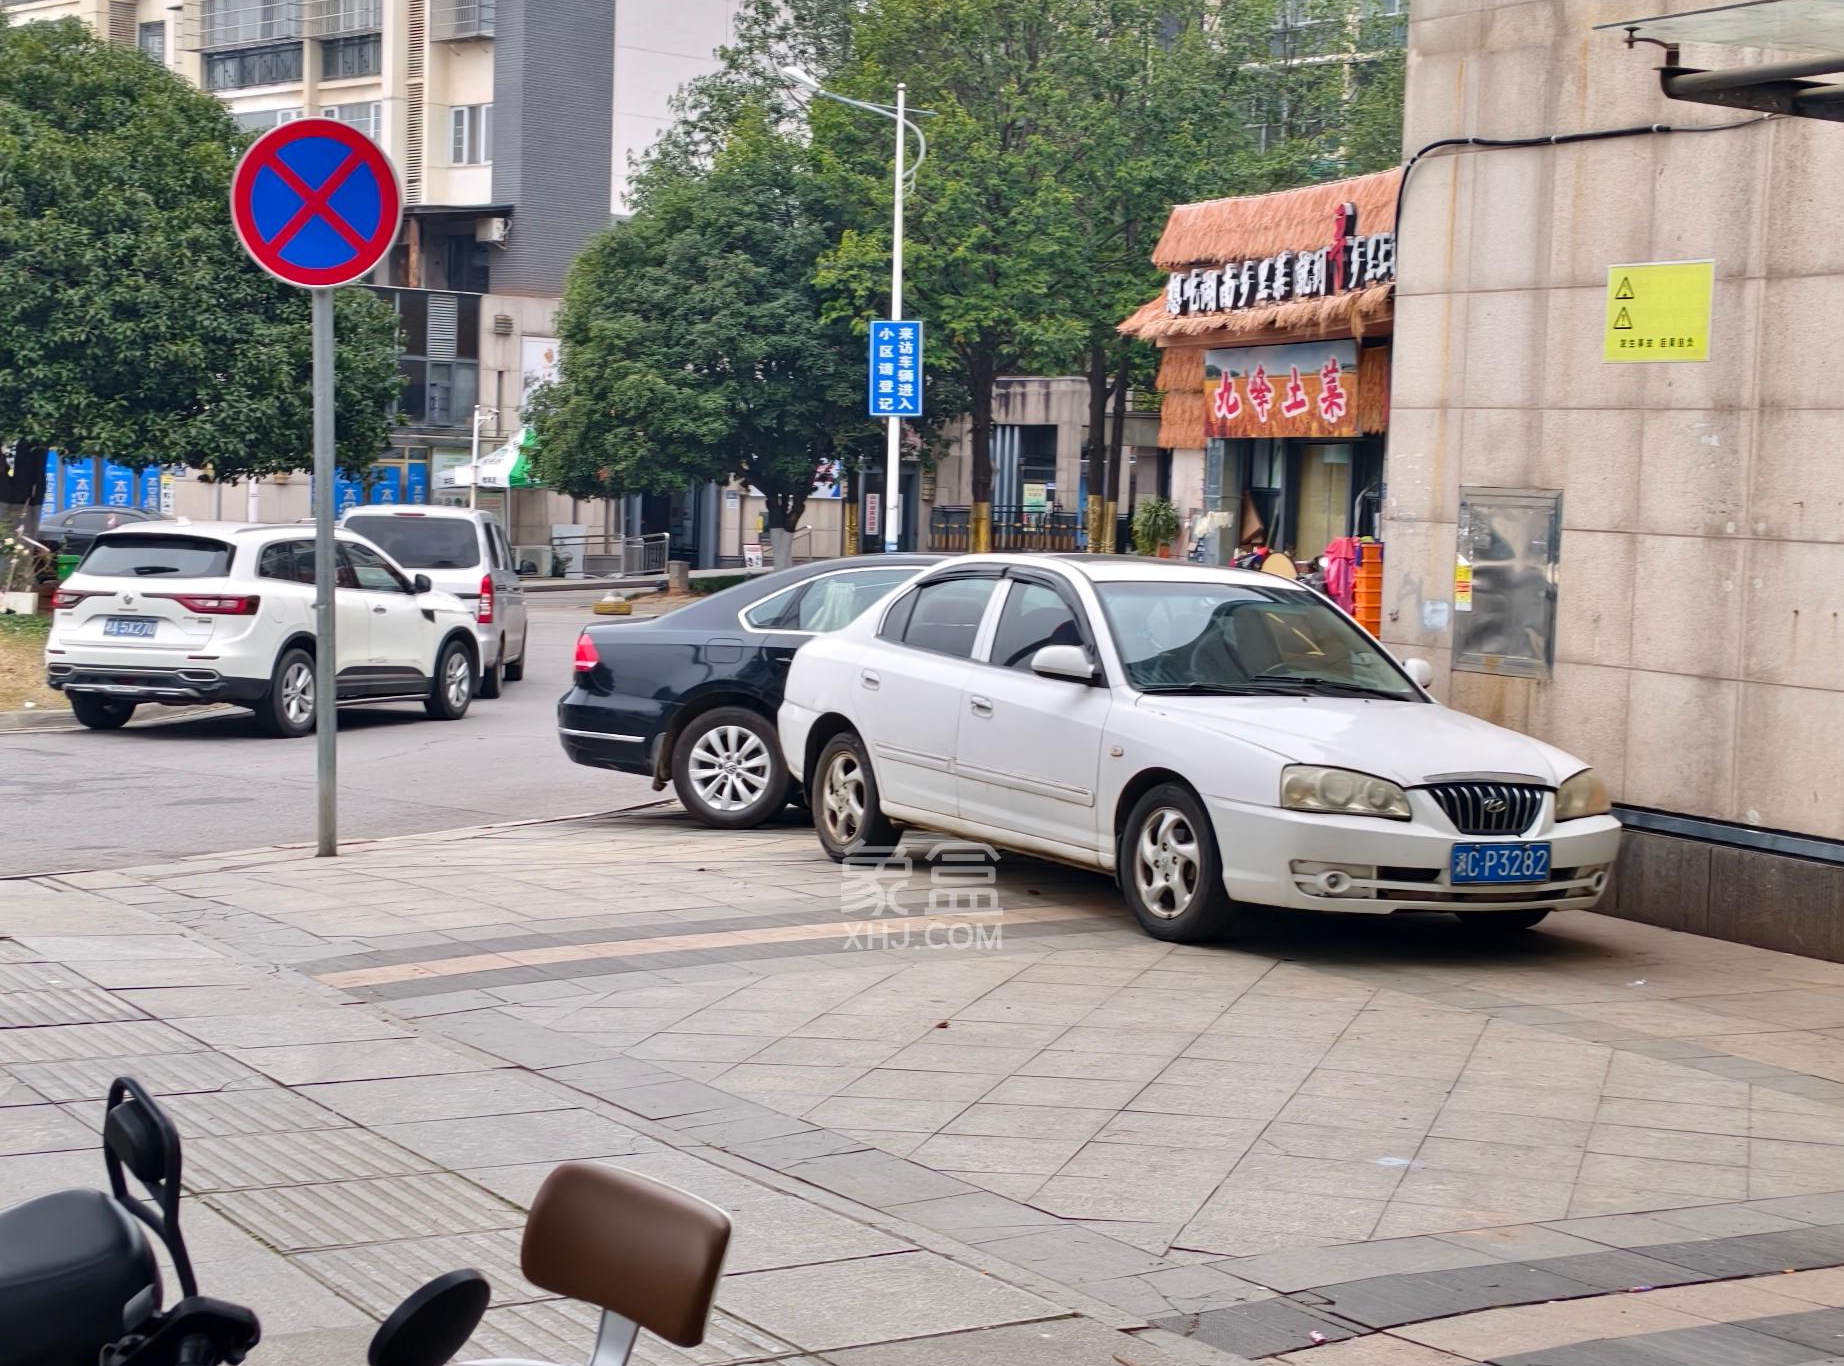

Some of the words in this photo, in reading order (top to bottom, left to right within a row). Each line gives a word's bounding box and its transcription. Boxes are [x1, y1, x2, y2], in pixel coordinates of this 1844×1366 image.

[878, 327, 895, 411] 小区请登记
[897, 327, 915, 410] 来访车辆进入
